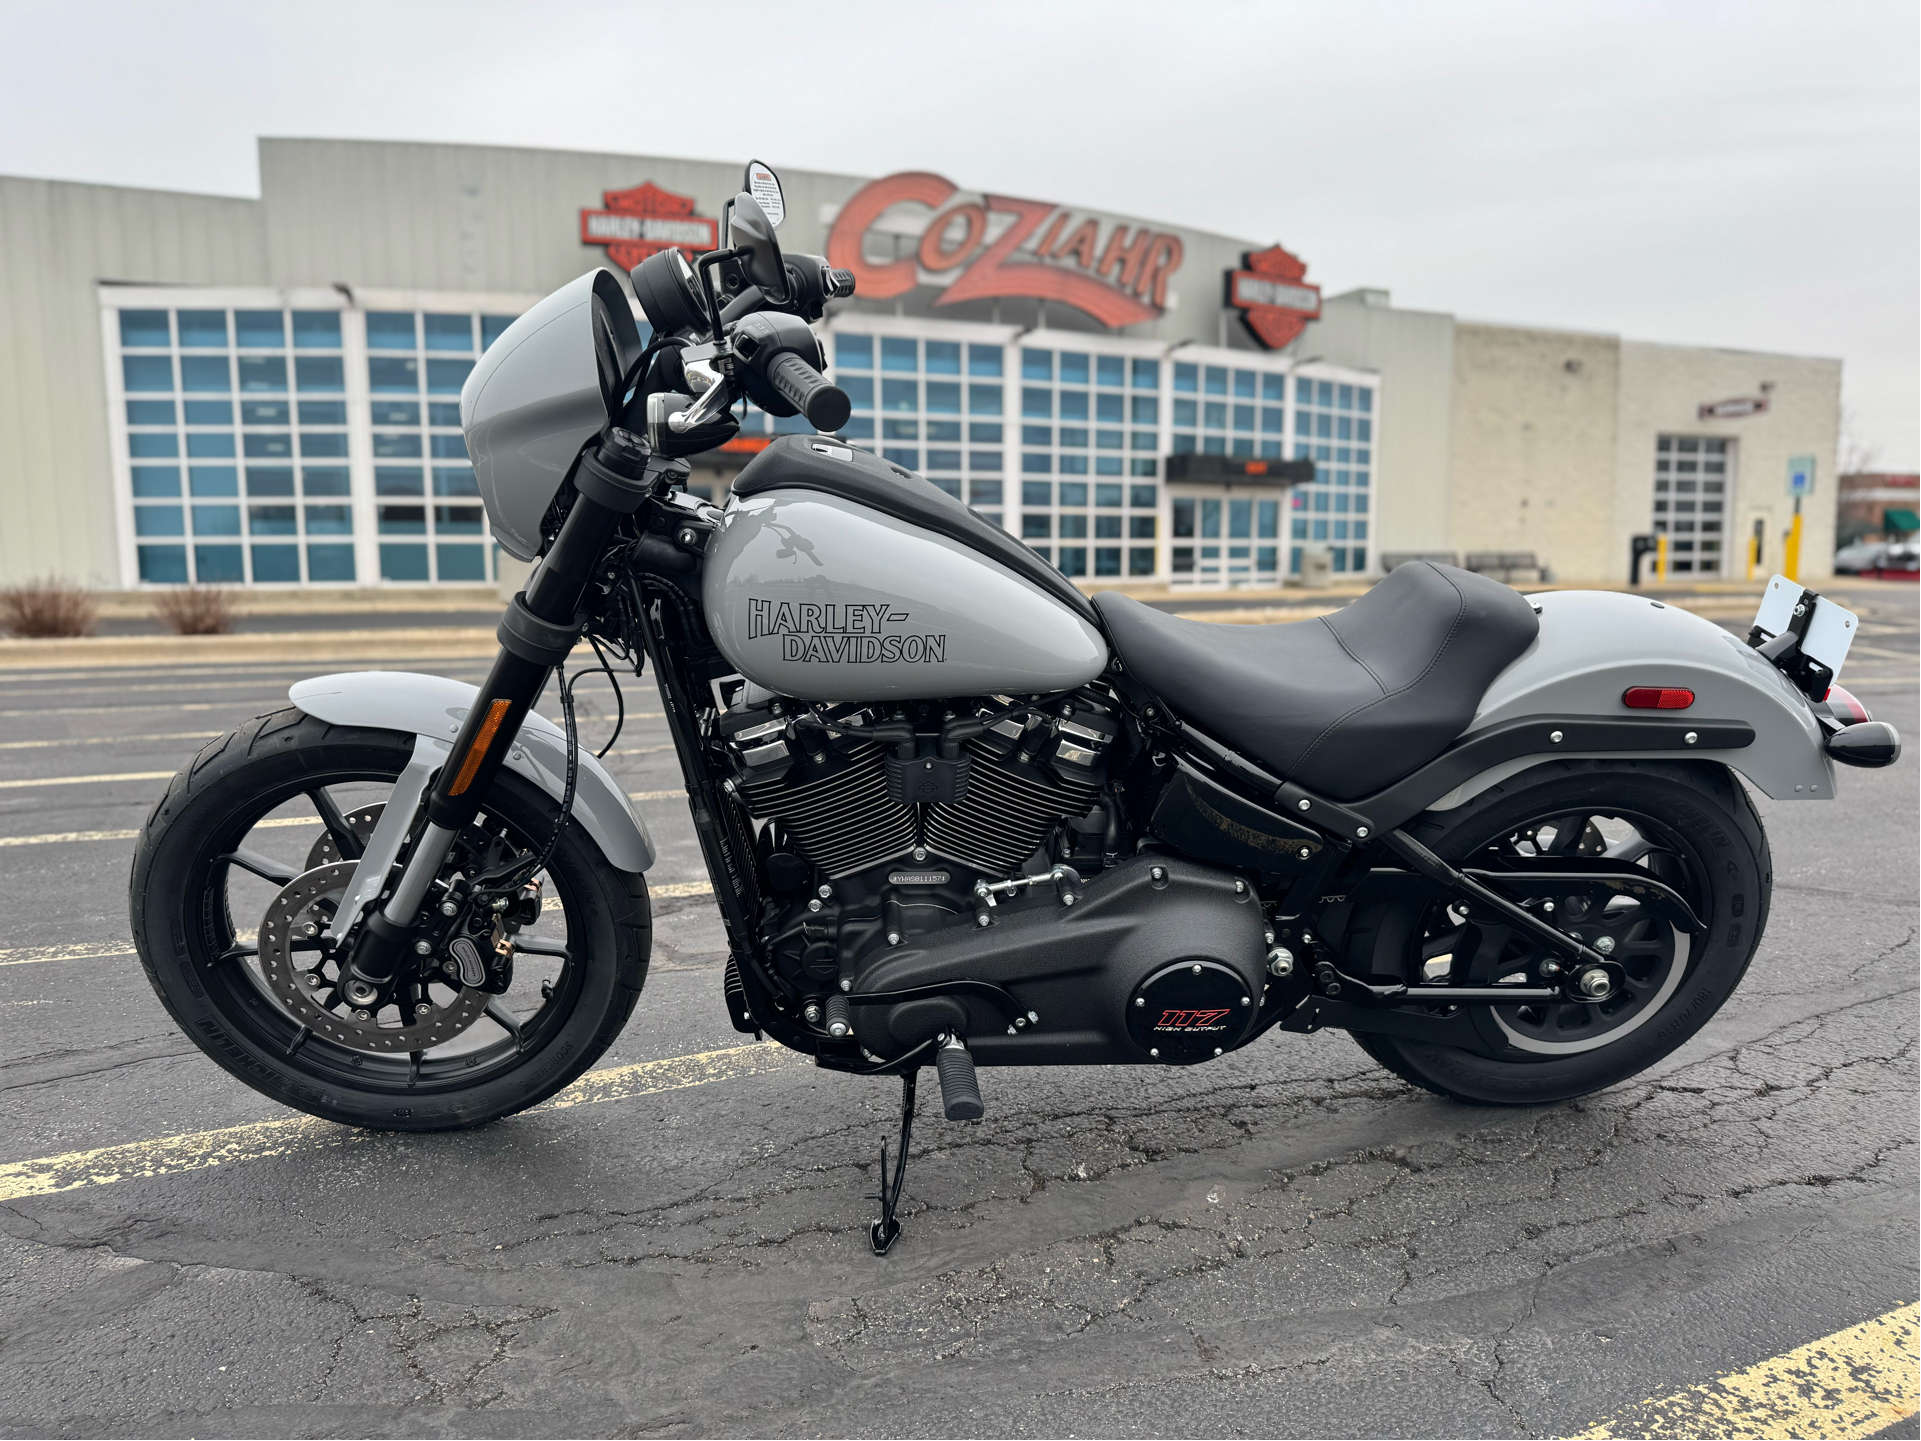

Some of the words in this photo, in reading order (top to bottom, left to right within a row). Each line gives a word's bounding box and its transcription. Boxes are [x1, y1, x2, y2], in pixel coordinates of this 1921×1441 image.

[748, 598, 910, 640] HARLEY-
[782, 634, 947, 663] DAVIDSON
[1157, 1008, 1231, 1026] 117
